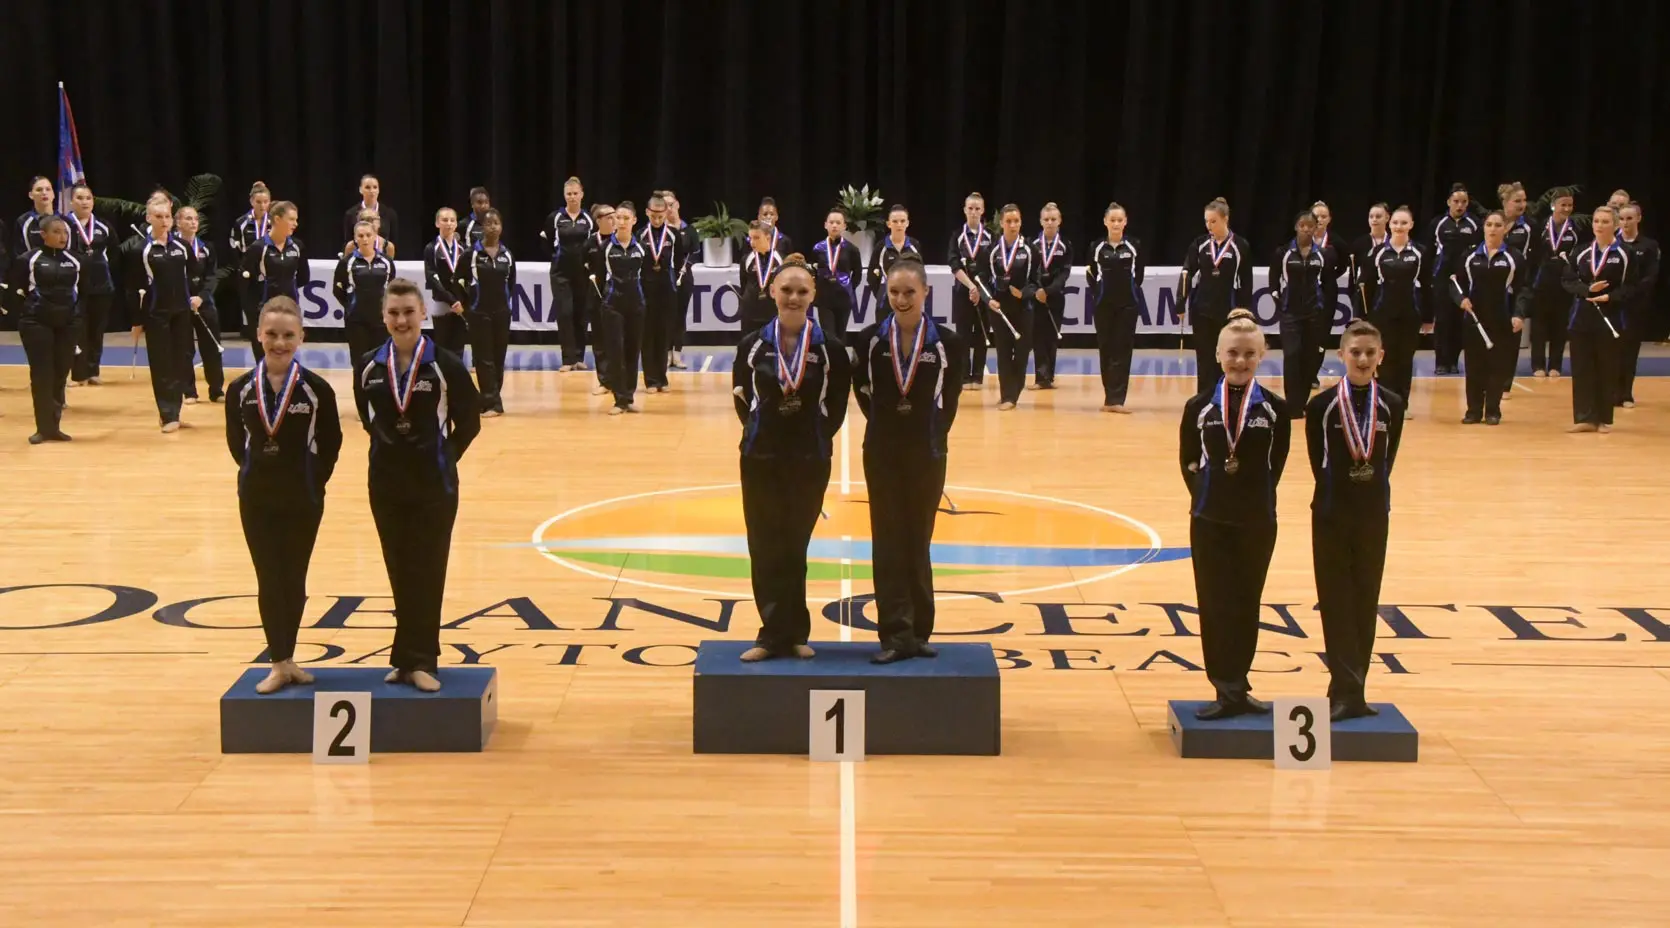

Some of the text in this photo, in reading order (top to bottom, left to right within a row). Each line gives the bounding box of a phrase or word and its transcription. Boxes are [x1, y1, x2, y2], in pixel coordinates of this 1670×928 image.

[0, 583, 755, 632] OCEAN
[328, 700, 357, 757] 2
[825, 698, 846, 754] 1
[1288, 705, 1316, 762] 3
